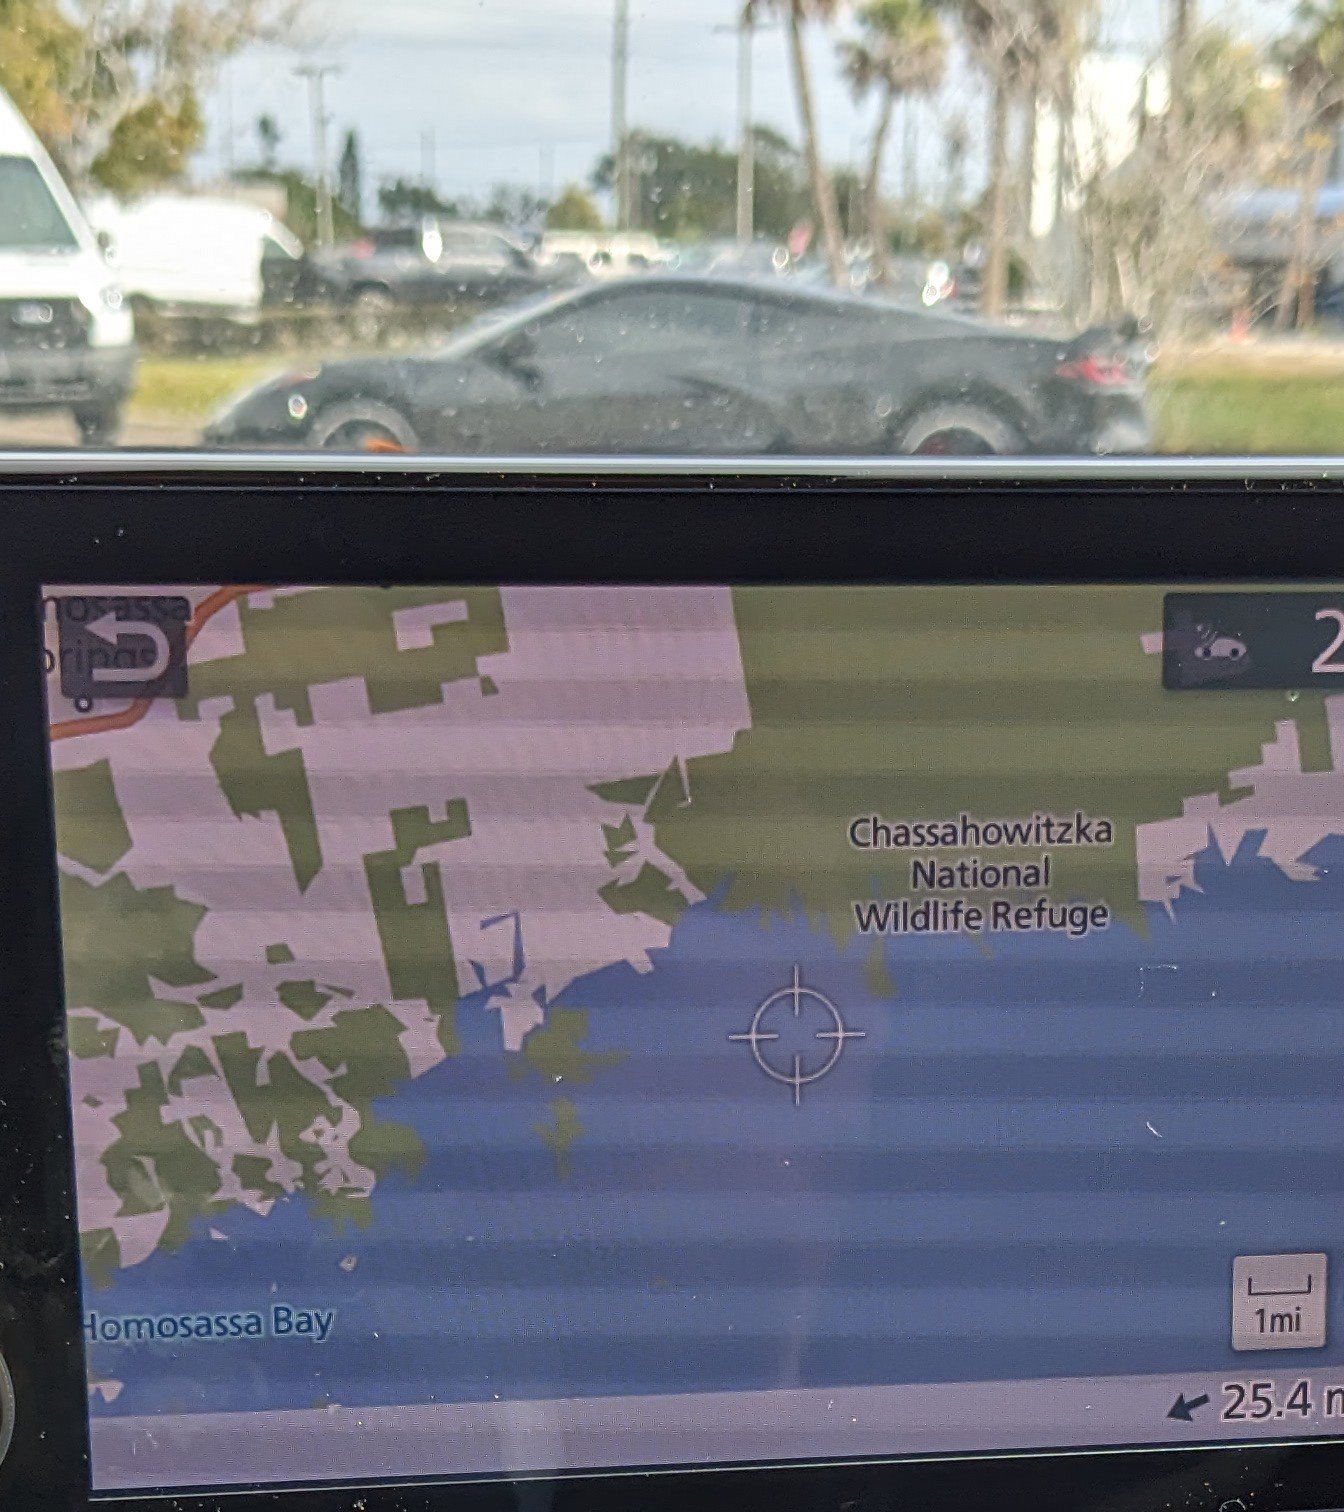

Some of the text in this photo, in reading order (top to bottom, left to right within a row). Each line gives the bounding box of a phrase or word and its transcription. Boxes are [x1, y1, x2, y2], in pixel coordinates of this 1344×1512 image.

[849, 811, 1112, 848] Chassahowitzka
[911, 854, 1049, 889] National
[855, 899, 1109, 935] Wildlife Refuge
[271, 1306, 335, 1342] Bay
[1222, 1380, 1312, 1420] 25.4
